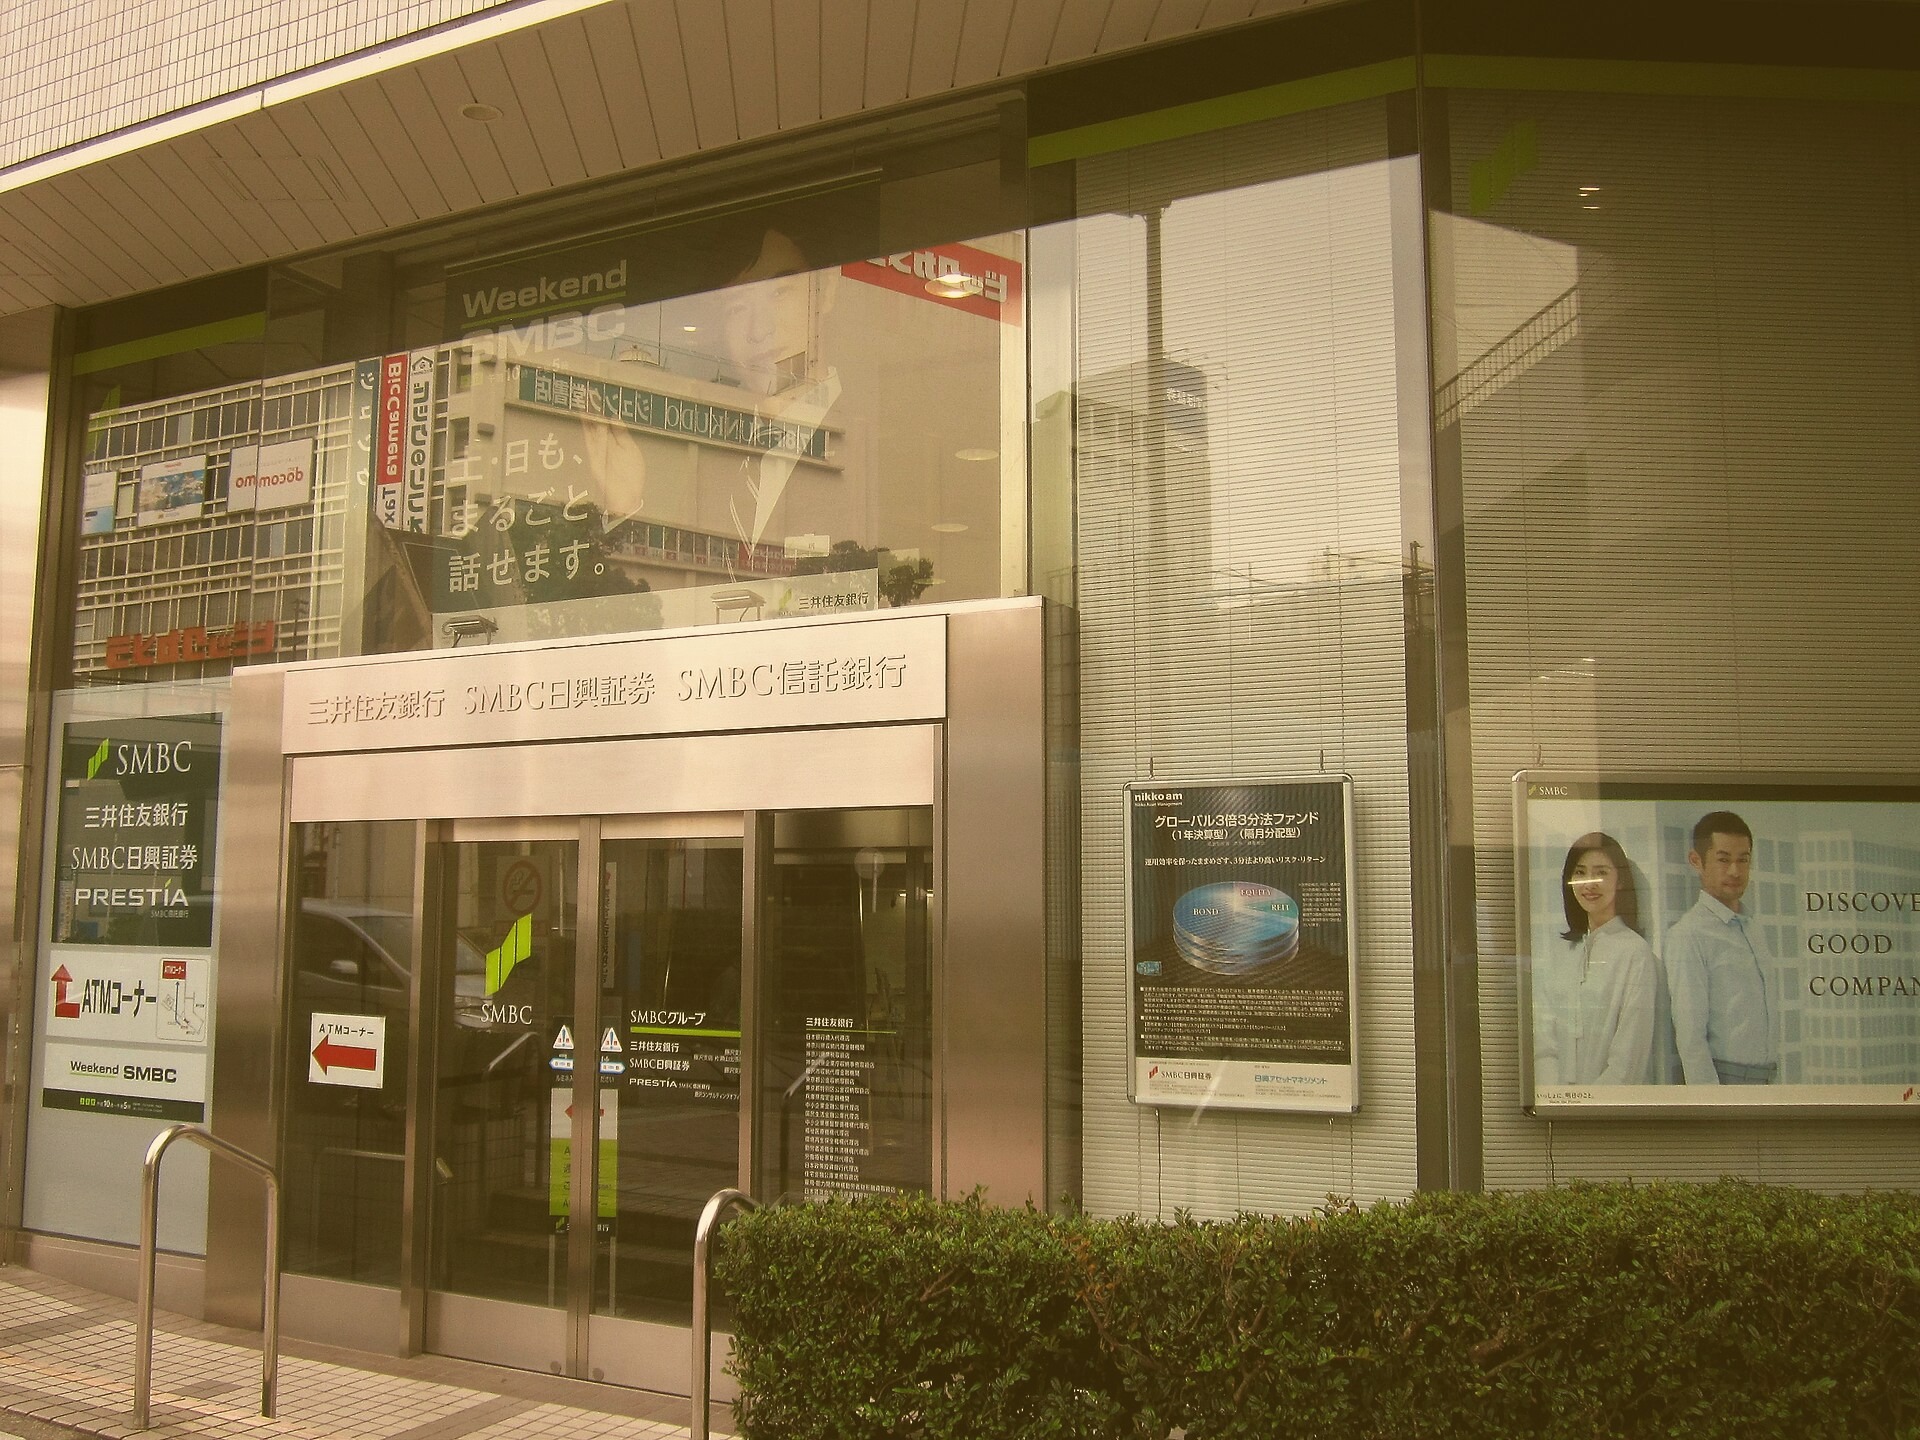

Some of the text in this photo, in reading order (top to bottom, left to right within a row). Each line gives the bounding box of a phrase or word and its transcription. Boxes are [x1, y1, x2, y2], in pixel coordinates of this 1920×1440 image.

[463, 259, 628, 318] Weekend
[461, 302, 626, 364] SMBC
[798, 591, 869, 610] 三井住友銀行
[307, 653, 908, 727] 三井住友銀行 SMBC日興証券 SMBC信託銀行
[116, 740, 193, 776] SMBC
[1134, 792, 1183, 802] nikko am
[1539, 786, 1568, 796] SMBC
[84, 802, 189, 829] 三井住友銀行
[1154, 811, 1319, 829] グローバル3倍3分法ファンド
[71, 844, 198, 870] SMBC日興証券
[1193, 907, 1219, 916] BOND
[1807, 933, 1893, 955] GOOD
[82, 979, 157, 1018] ATMコーナー
[481, 1004, 533, 1025] SMBC
[630, 1010, 707, 1026] SMBCグループ
[805, 1017, 854, 1028] 三井住友銀行
[318, 1023, 375, 1037] ATMコーナー
[630, 1040, 680, 1053] 三井住友銀行
[70, 1060, 177, 1083] Weekend SMBC
[629, 1057, 691, 1072] SMBC日興証券
